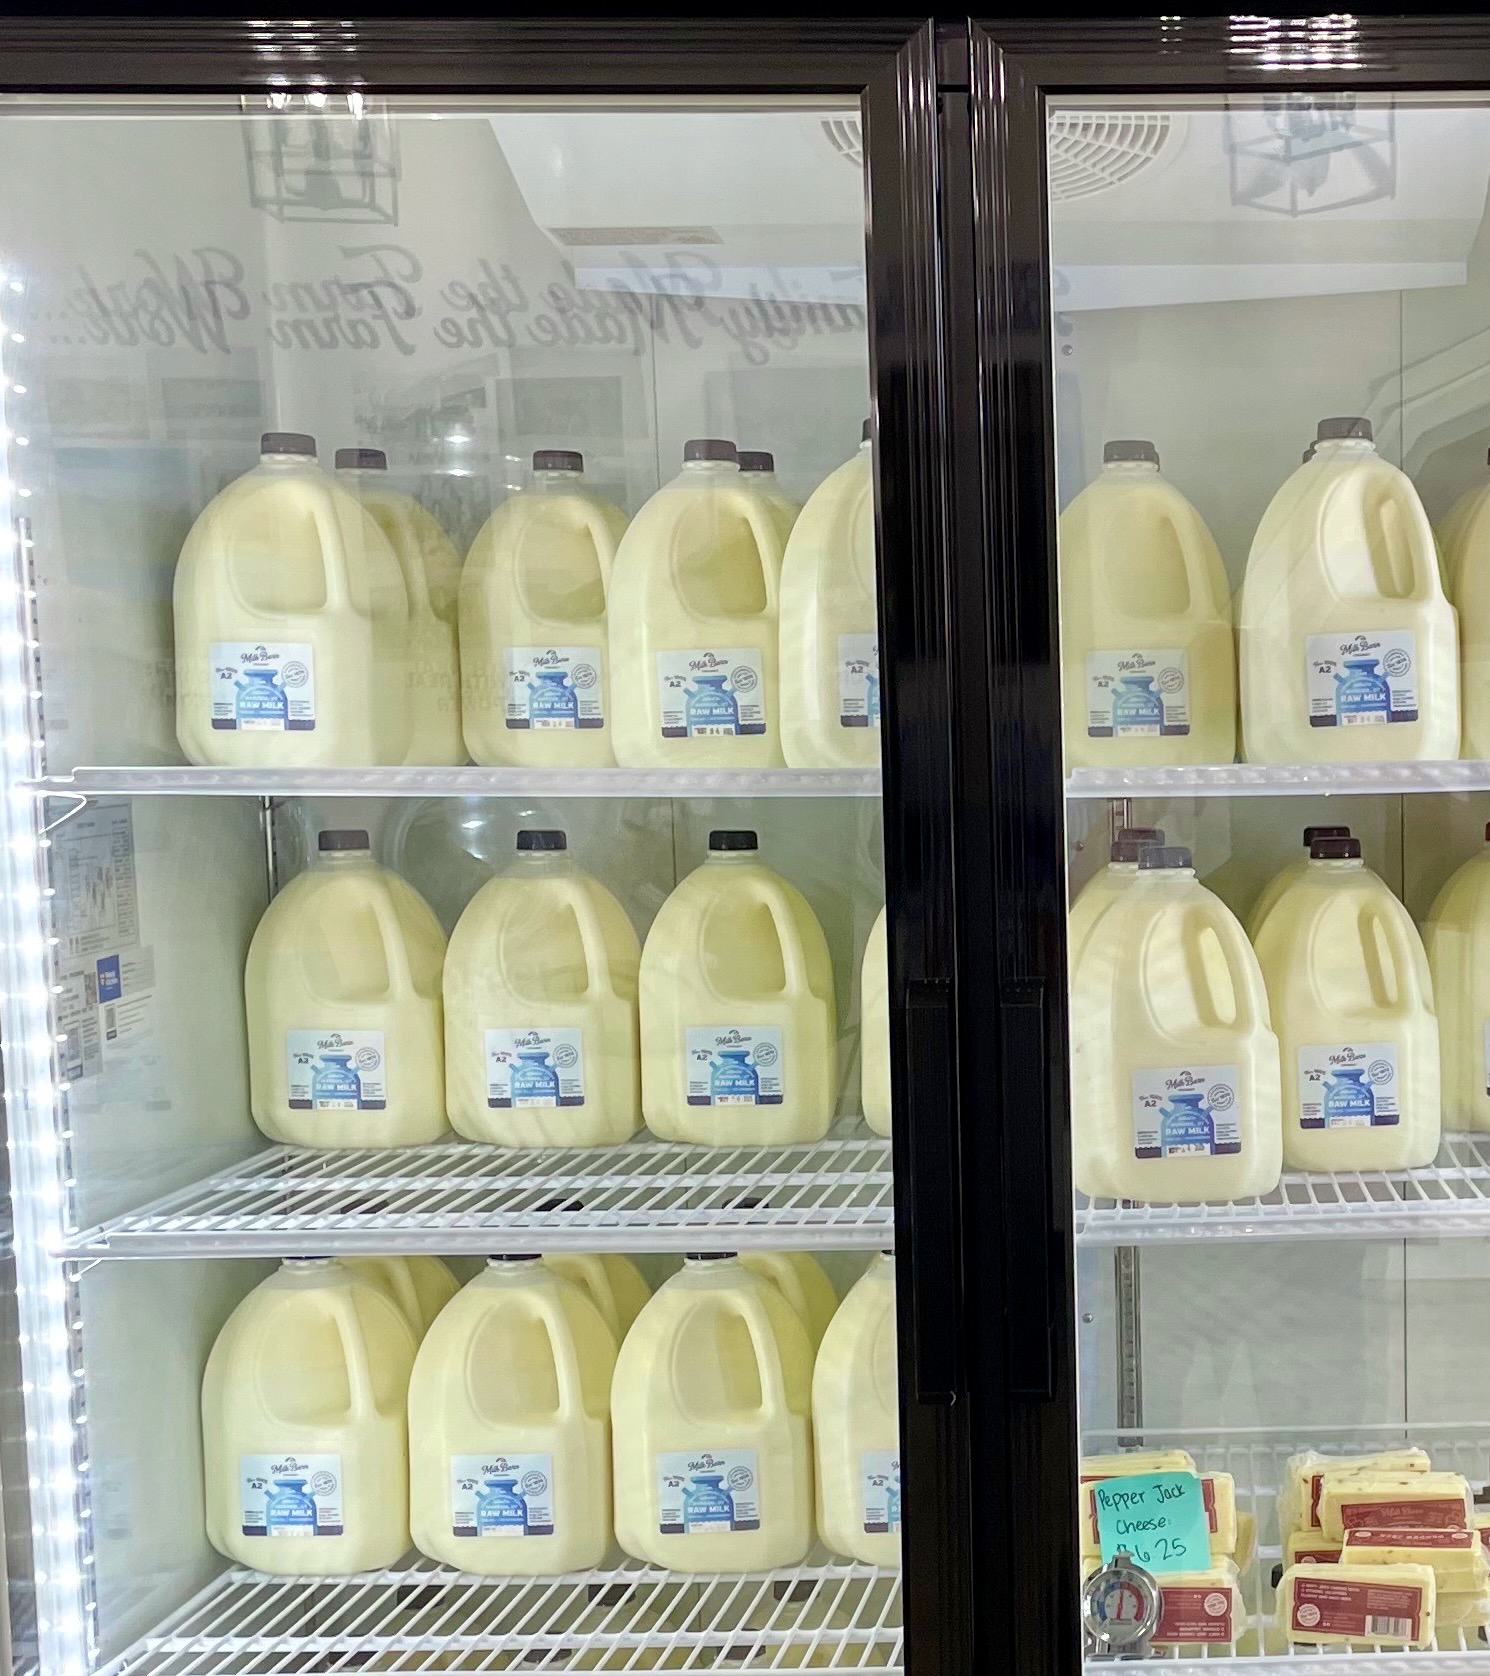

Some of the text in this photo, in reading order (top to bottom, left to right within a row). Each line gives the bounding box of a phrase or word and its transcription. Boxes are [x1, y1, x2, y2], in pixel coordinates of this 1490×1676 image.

[1364, 693, 1386, 701] MILK
[262, 701, 284, 709] MILK
[1098, 1484, 1185, 1512] Pepper Jack
